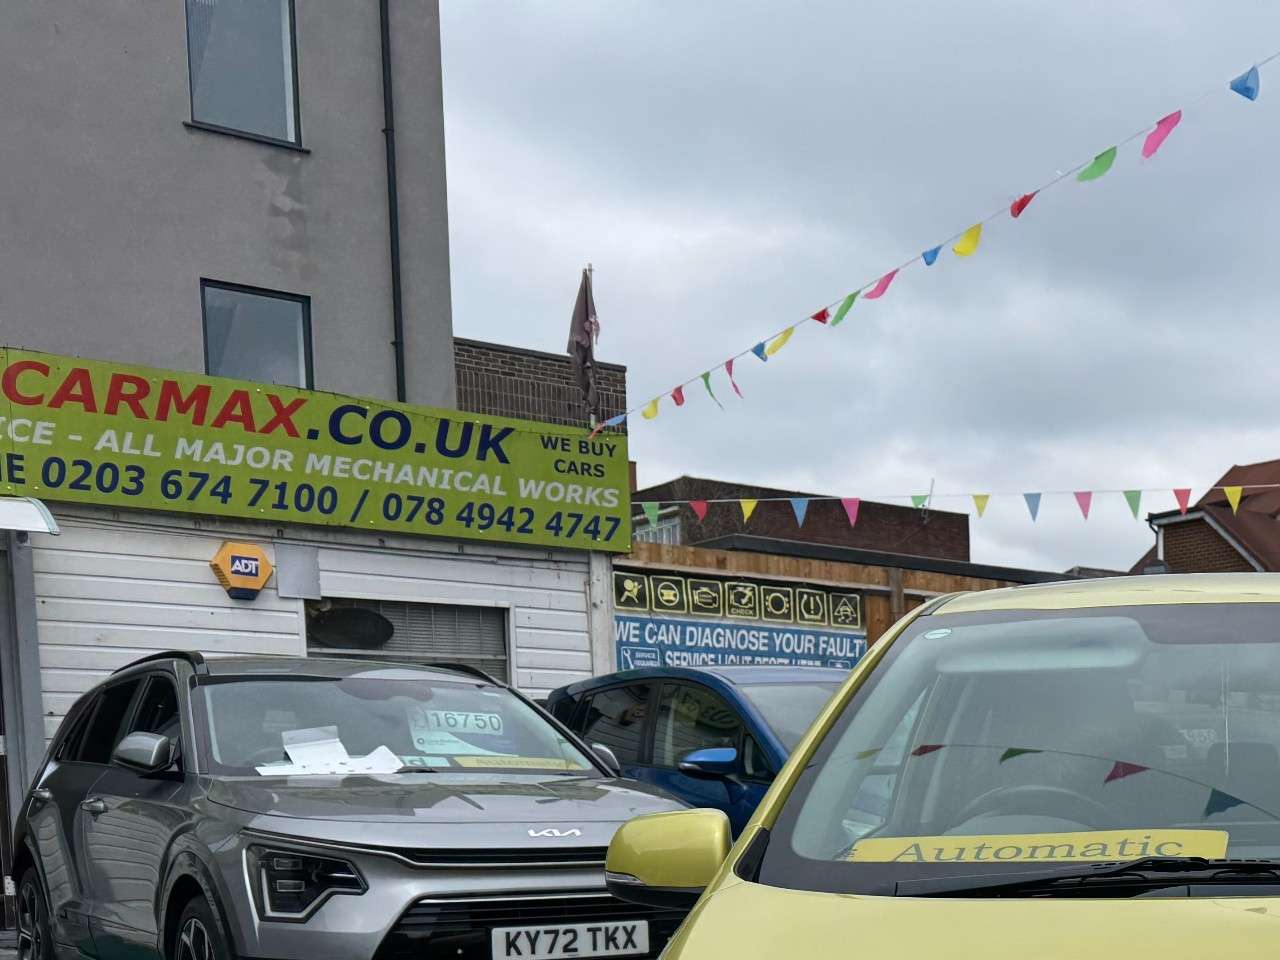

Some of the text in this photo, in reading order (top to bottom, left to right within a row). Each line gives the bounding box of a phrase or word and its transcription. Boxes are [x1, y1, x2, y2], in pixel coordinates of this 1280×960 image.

[1, 360, 516, 464] CARMAX.CO.UK
[540, 435, 617, 458] WE BUY
[94, 429, 161, 457] ALL
[175, 438, 293, 472] MAJOR
[305, 453, 507, 496] MECHANICAL
[518, 478, 620, 508] WORKS
[553, 458, 605, 478] CARS
[0, 451, 621, 542] E 0203 674 7100 / 078 4942 4747
[231, 559, 259, 574] ADT
[614, 621, 640, 643] WE
[645, 623, 680, 645] CAN
[686, 626, 769, 651] DIAGNOSE
[773, 632, 816, 654] YOUR
[892, 835, 1184, 862] Automatic
[505, 925, 637, 957] KY72 TKX
